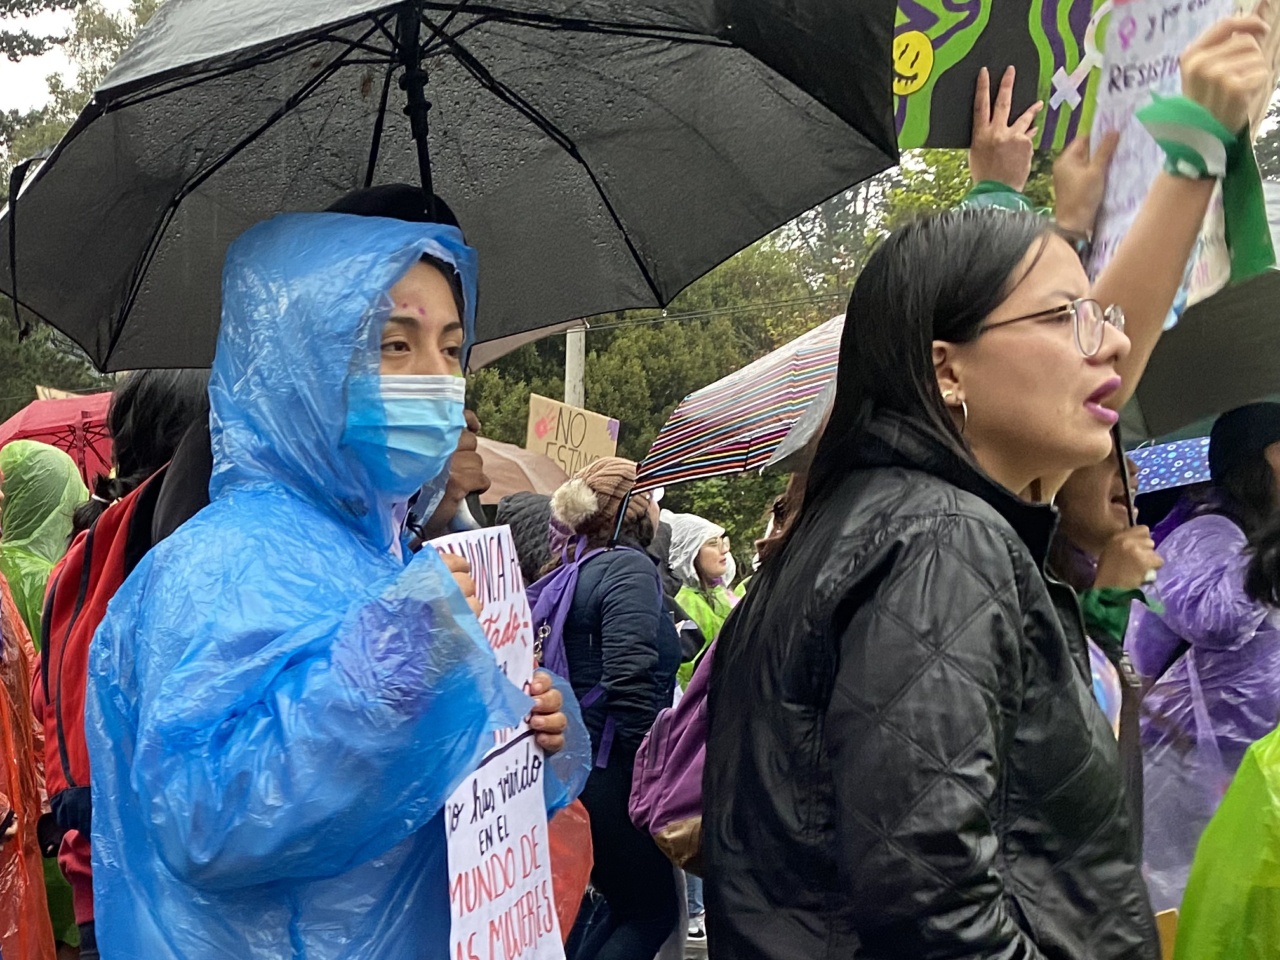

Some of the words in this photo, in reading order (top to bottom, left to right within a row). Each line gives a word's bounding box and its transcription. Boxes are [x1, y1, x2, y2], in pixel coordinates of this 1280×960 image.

[555, 407, 587, 448] NO
[470, 777, 496, 824] has
[497, 742, 543, 802] vivido
[479, 825, 493, 856] EN
[497, 814, 510, 843] EL
[449, 847, 516, 918] MUNDO
[520, 825, 542, 879] DE
